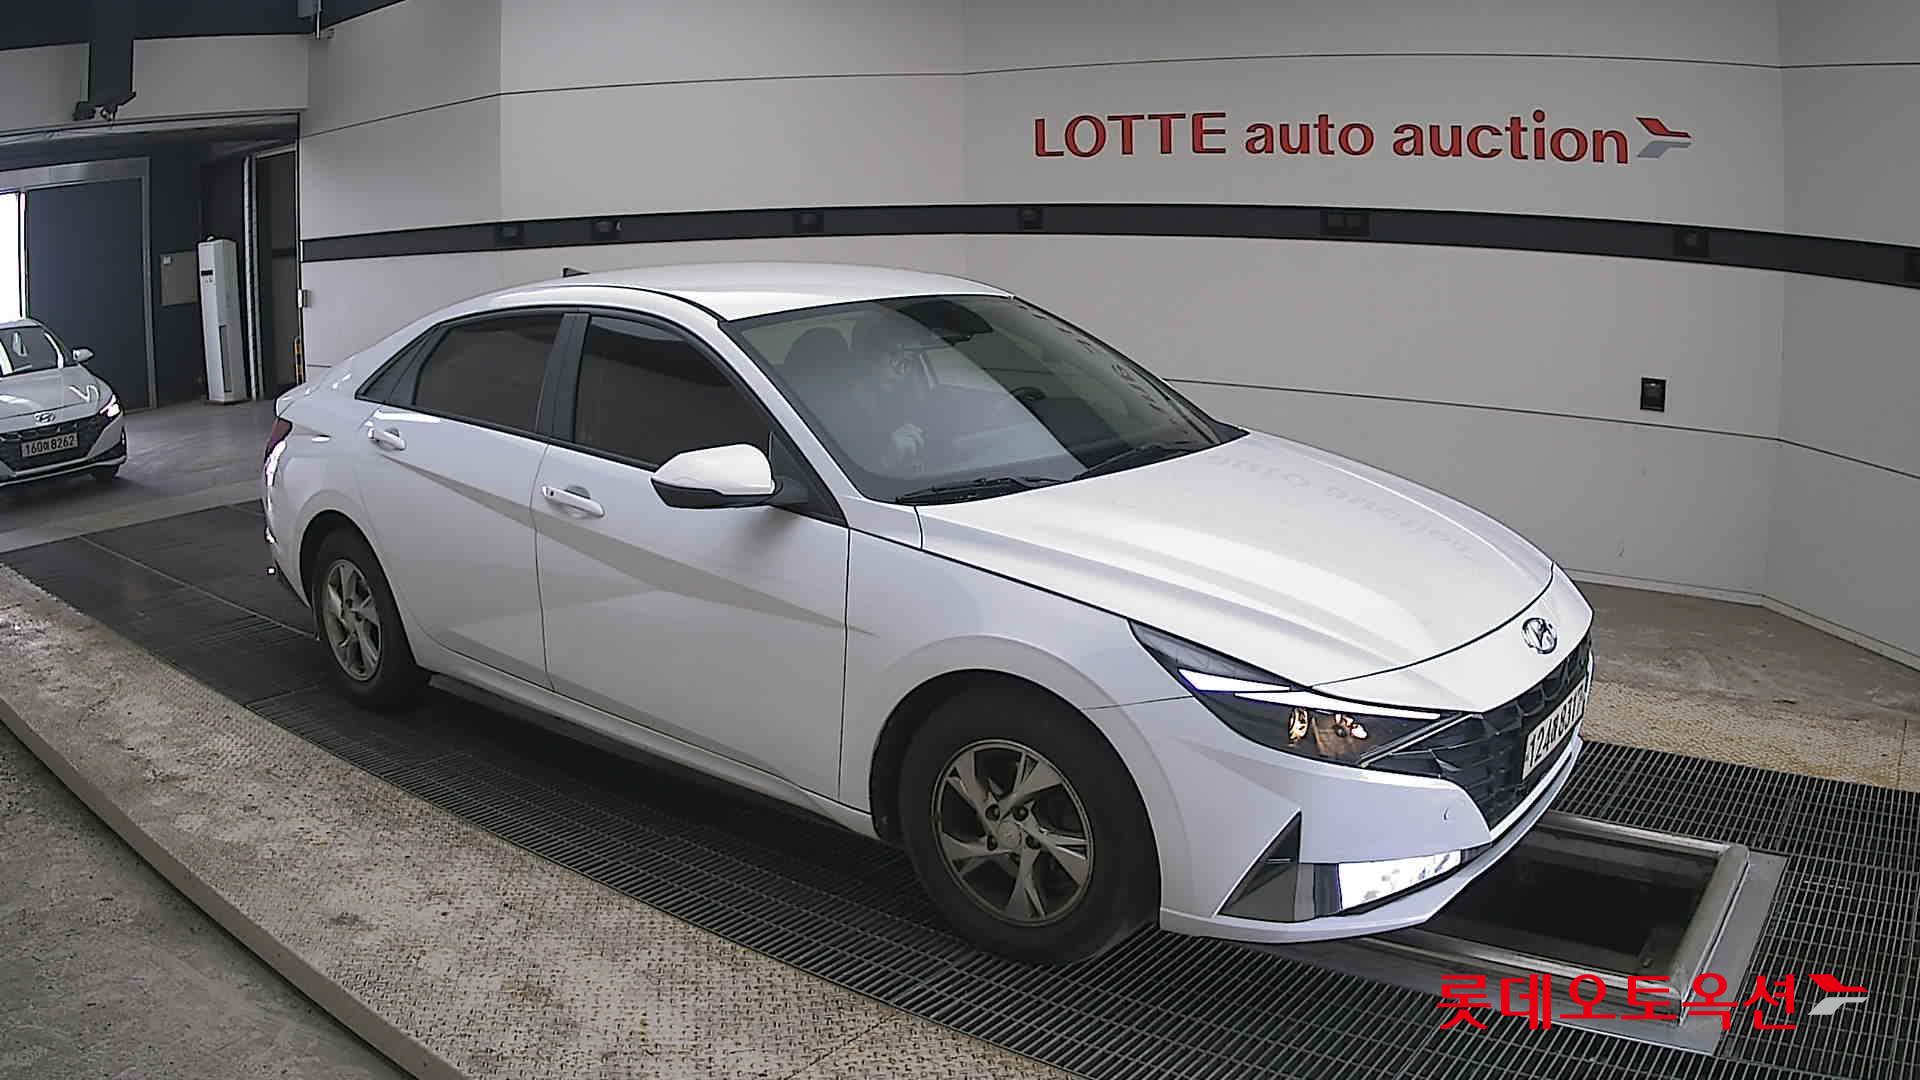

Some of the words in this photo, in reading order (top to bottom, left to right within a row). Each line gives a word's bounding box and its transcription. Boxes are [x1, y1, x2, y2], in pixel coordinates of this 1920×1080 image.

[1035, 112, 1227, 158] LOTTE
[1245, 114, 1375, 156] auto
[1392, 109, 1629, 164] auction
